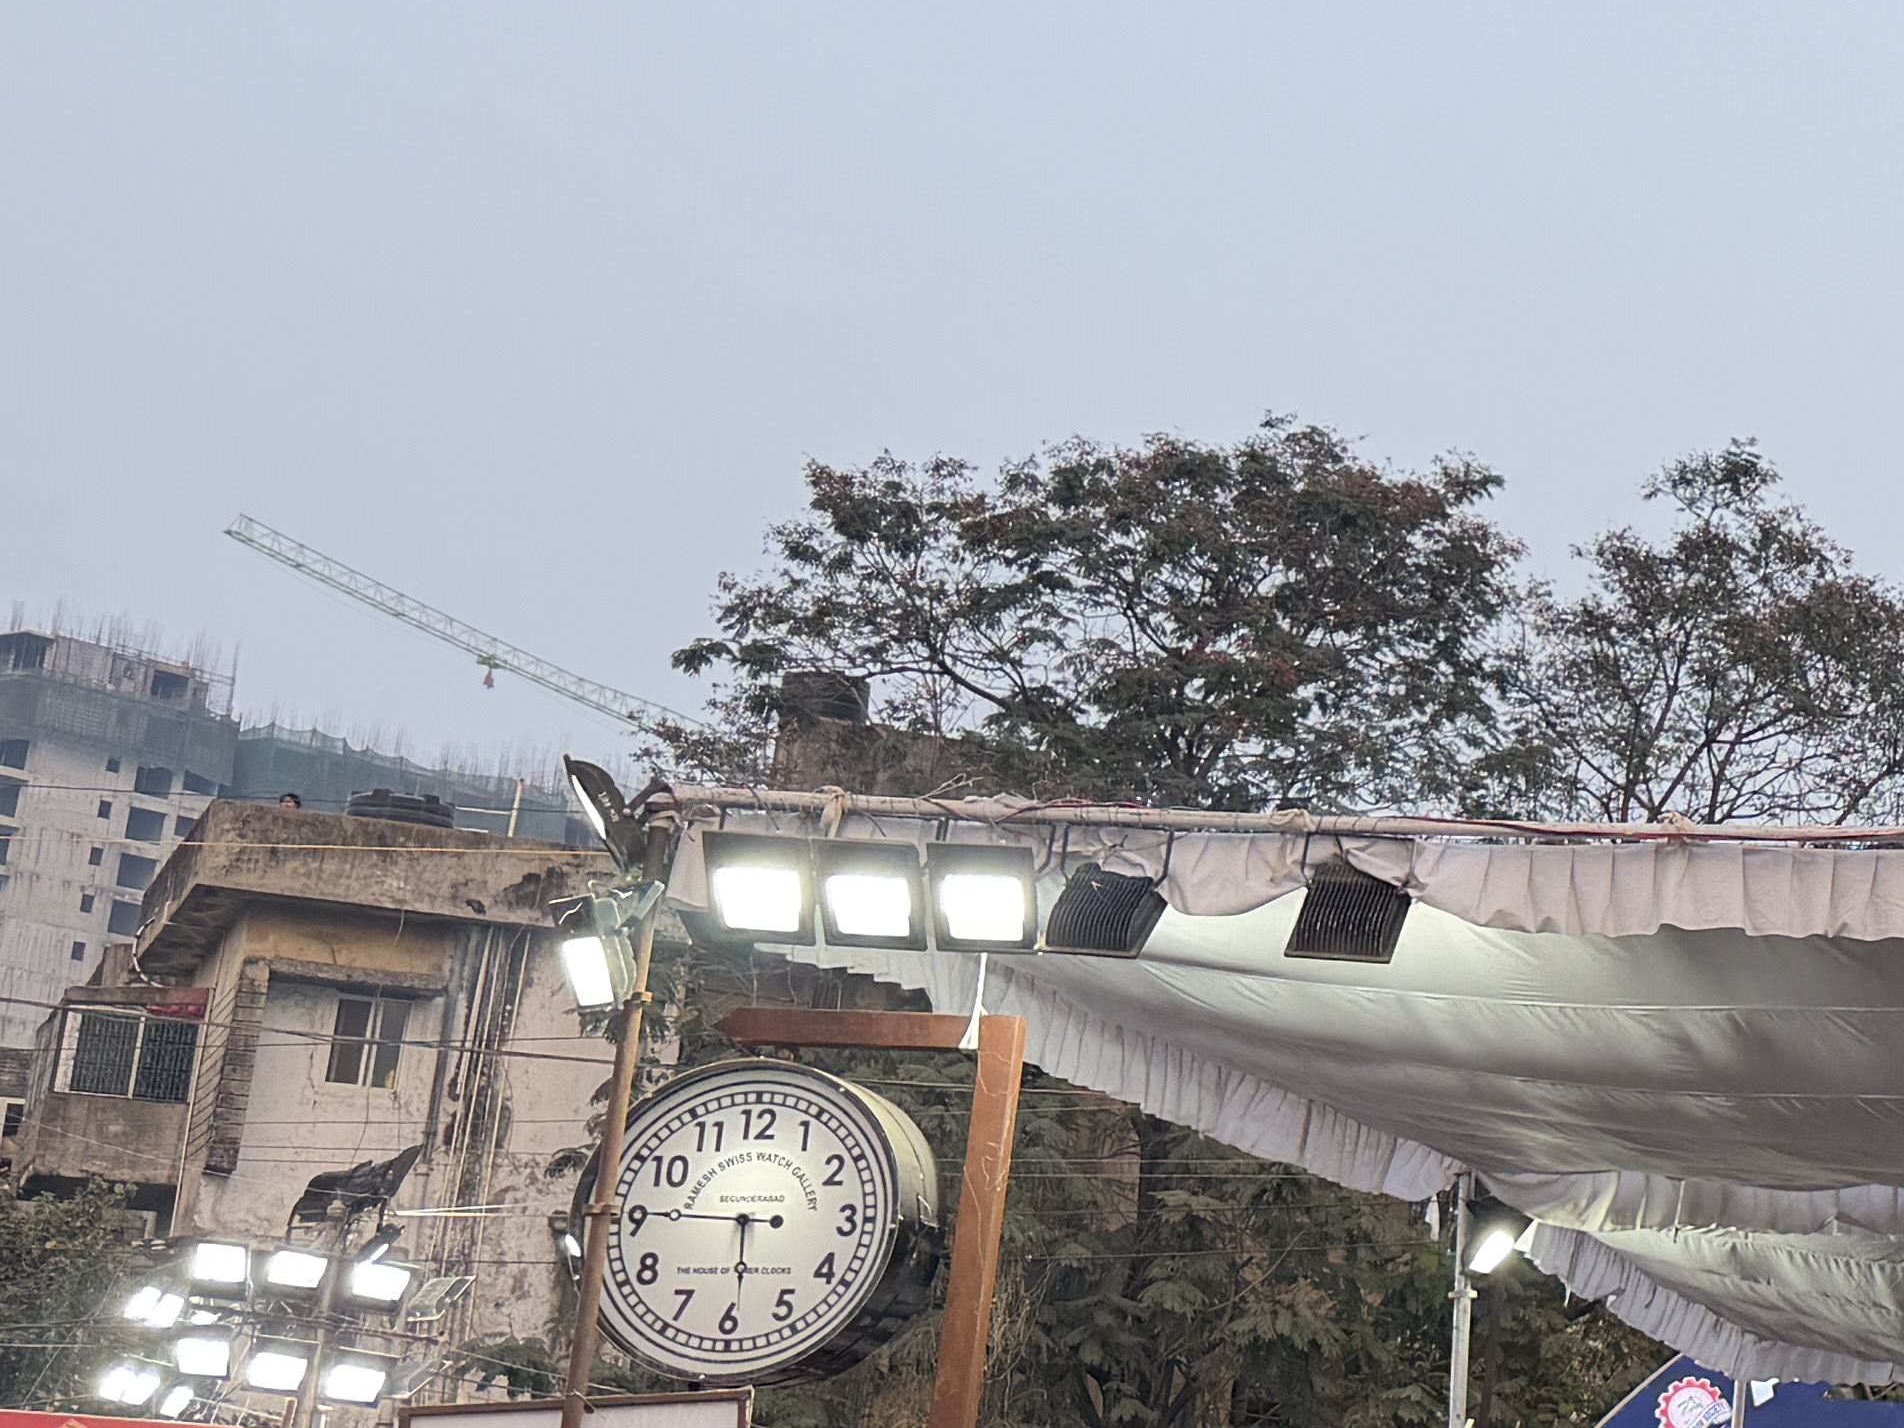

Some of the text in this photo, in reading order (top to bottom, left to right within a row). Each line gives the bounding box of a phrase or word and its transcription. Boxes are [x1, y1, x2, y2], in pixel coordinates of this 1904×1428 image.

[696, 1121, 724, 1152] 11
[740, 1109, 777, 1140] 12
[798, 1120, 810, 1151] 1
[652, 1155, 689, 1187] 10
[684, 1151, 818, 1212] RAMESH SWISS WATCH GALLERY
[822, 1154, 845, 1186] 2
[628, 1205, 648, 1237] 9
[836, 1205, 858, 1237] 3
[636, 1252, 659, 1285] 8
[813, 1252, 836, 1285] 4
[673, 1289, 695, 1321] 7
[718, 1301, 739, 1335] 6
[772, 1288, 796, 1321] 5
